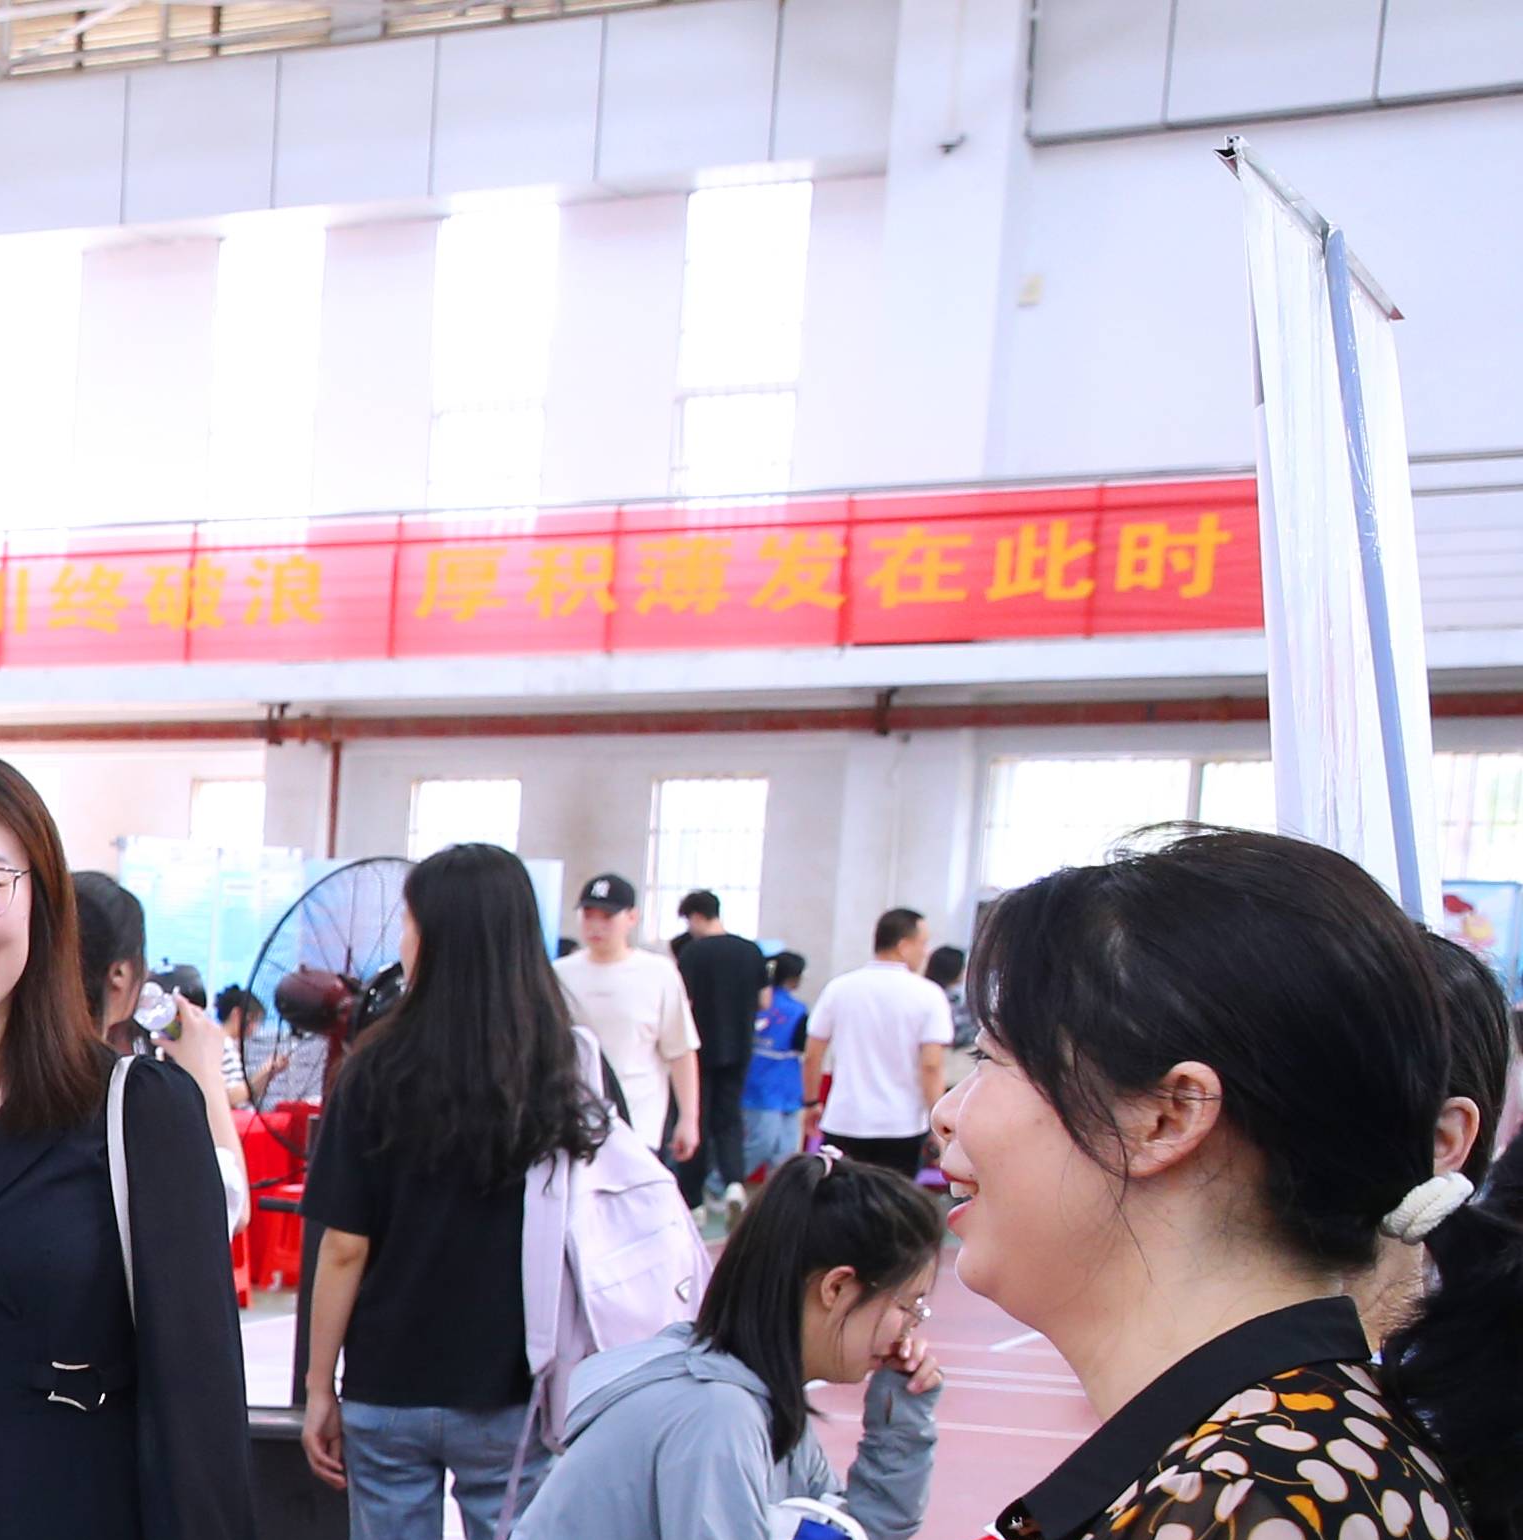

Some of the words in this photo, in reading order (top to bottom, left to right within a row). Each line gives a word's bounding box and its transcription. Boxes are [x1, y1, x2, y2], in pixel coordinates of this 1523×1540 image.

[413, 513, 1233, 623] 厚积薄发在此时
